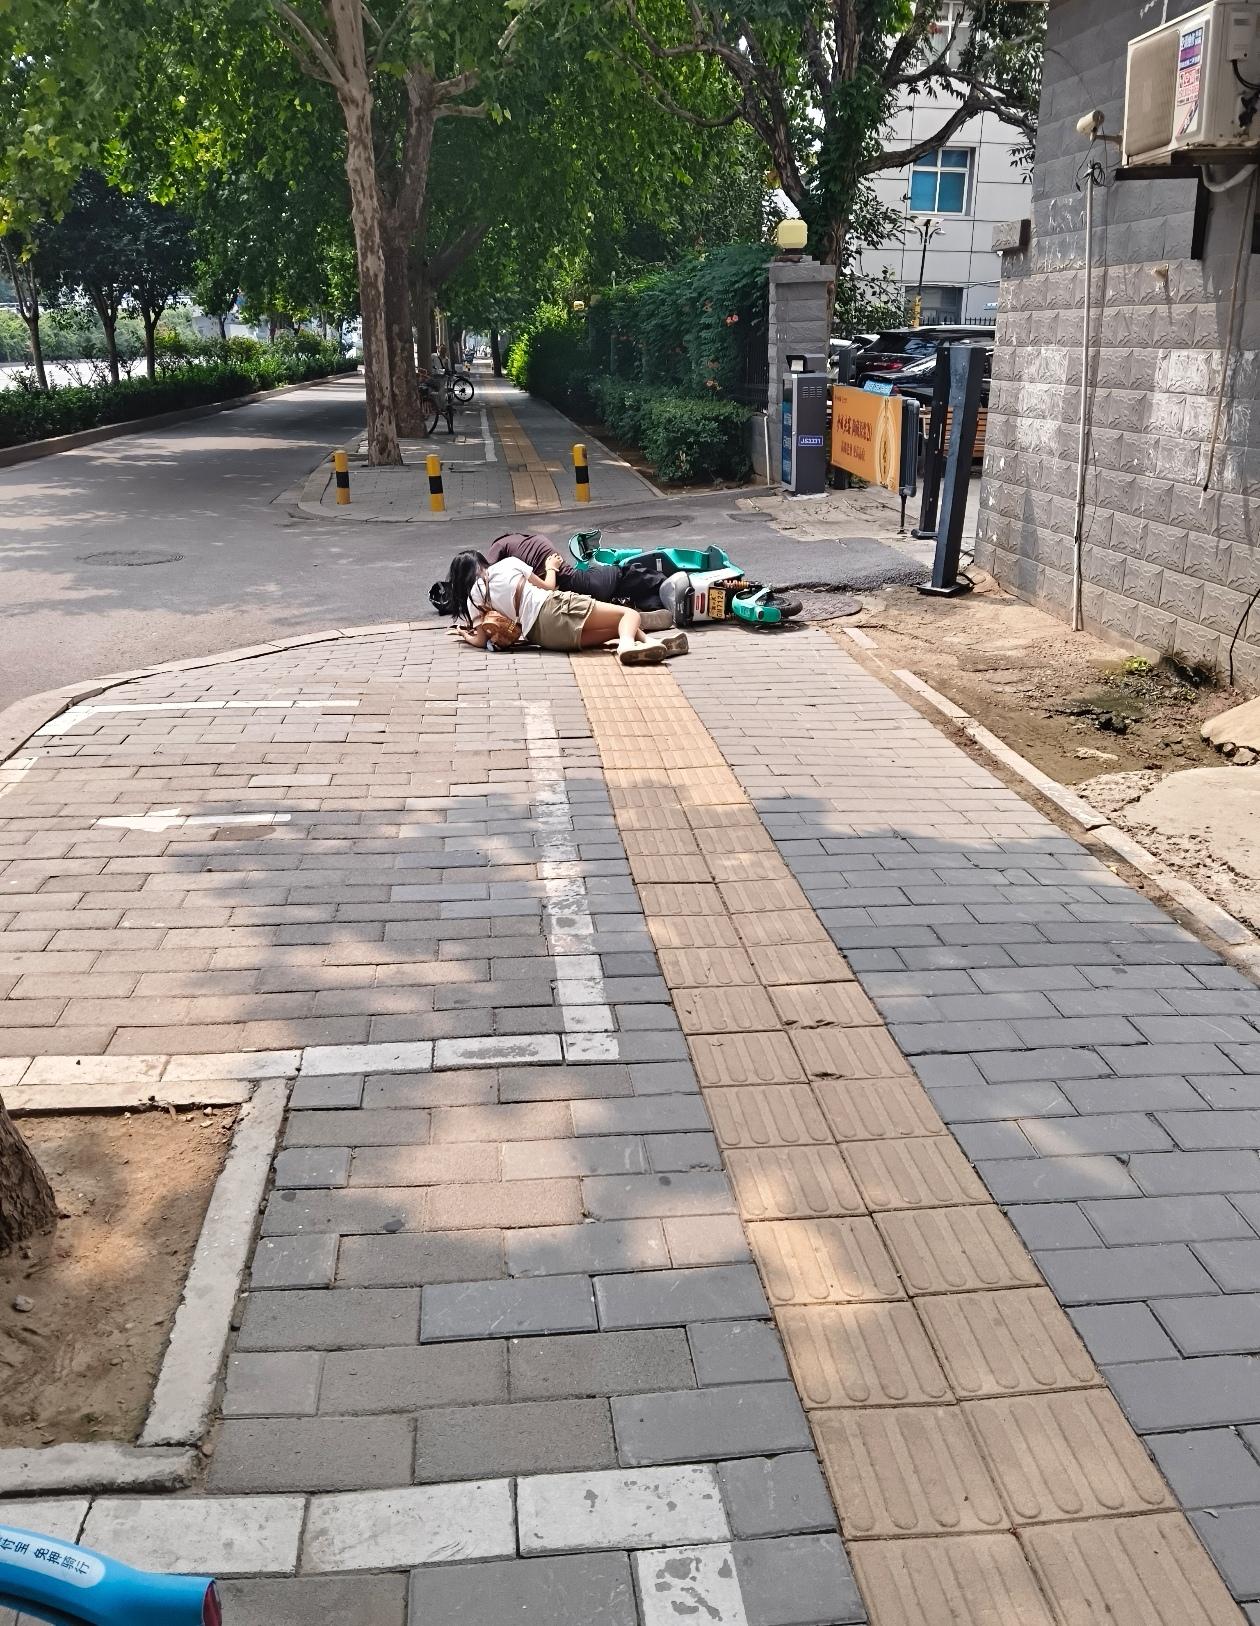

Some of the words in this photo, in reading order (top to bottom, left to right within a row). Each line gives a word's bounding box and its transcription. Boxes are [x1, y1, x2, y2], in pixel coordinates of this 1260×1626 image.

[0, 1537, 30, 1555] 付宝
[34, 1547, 90, 1574] 免押骑行
